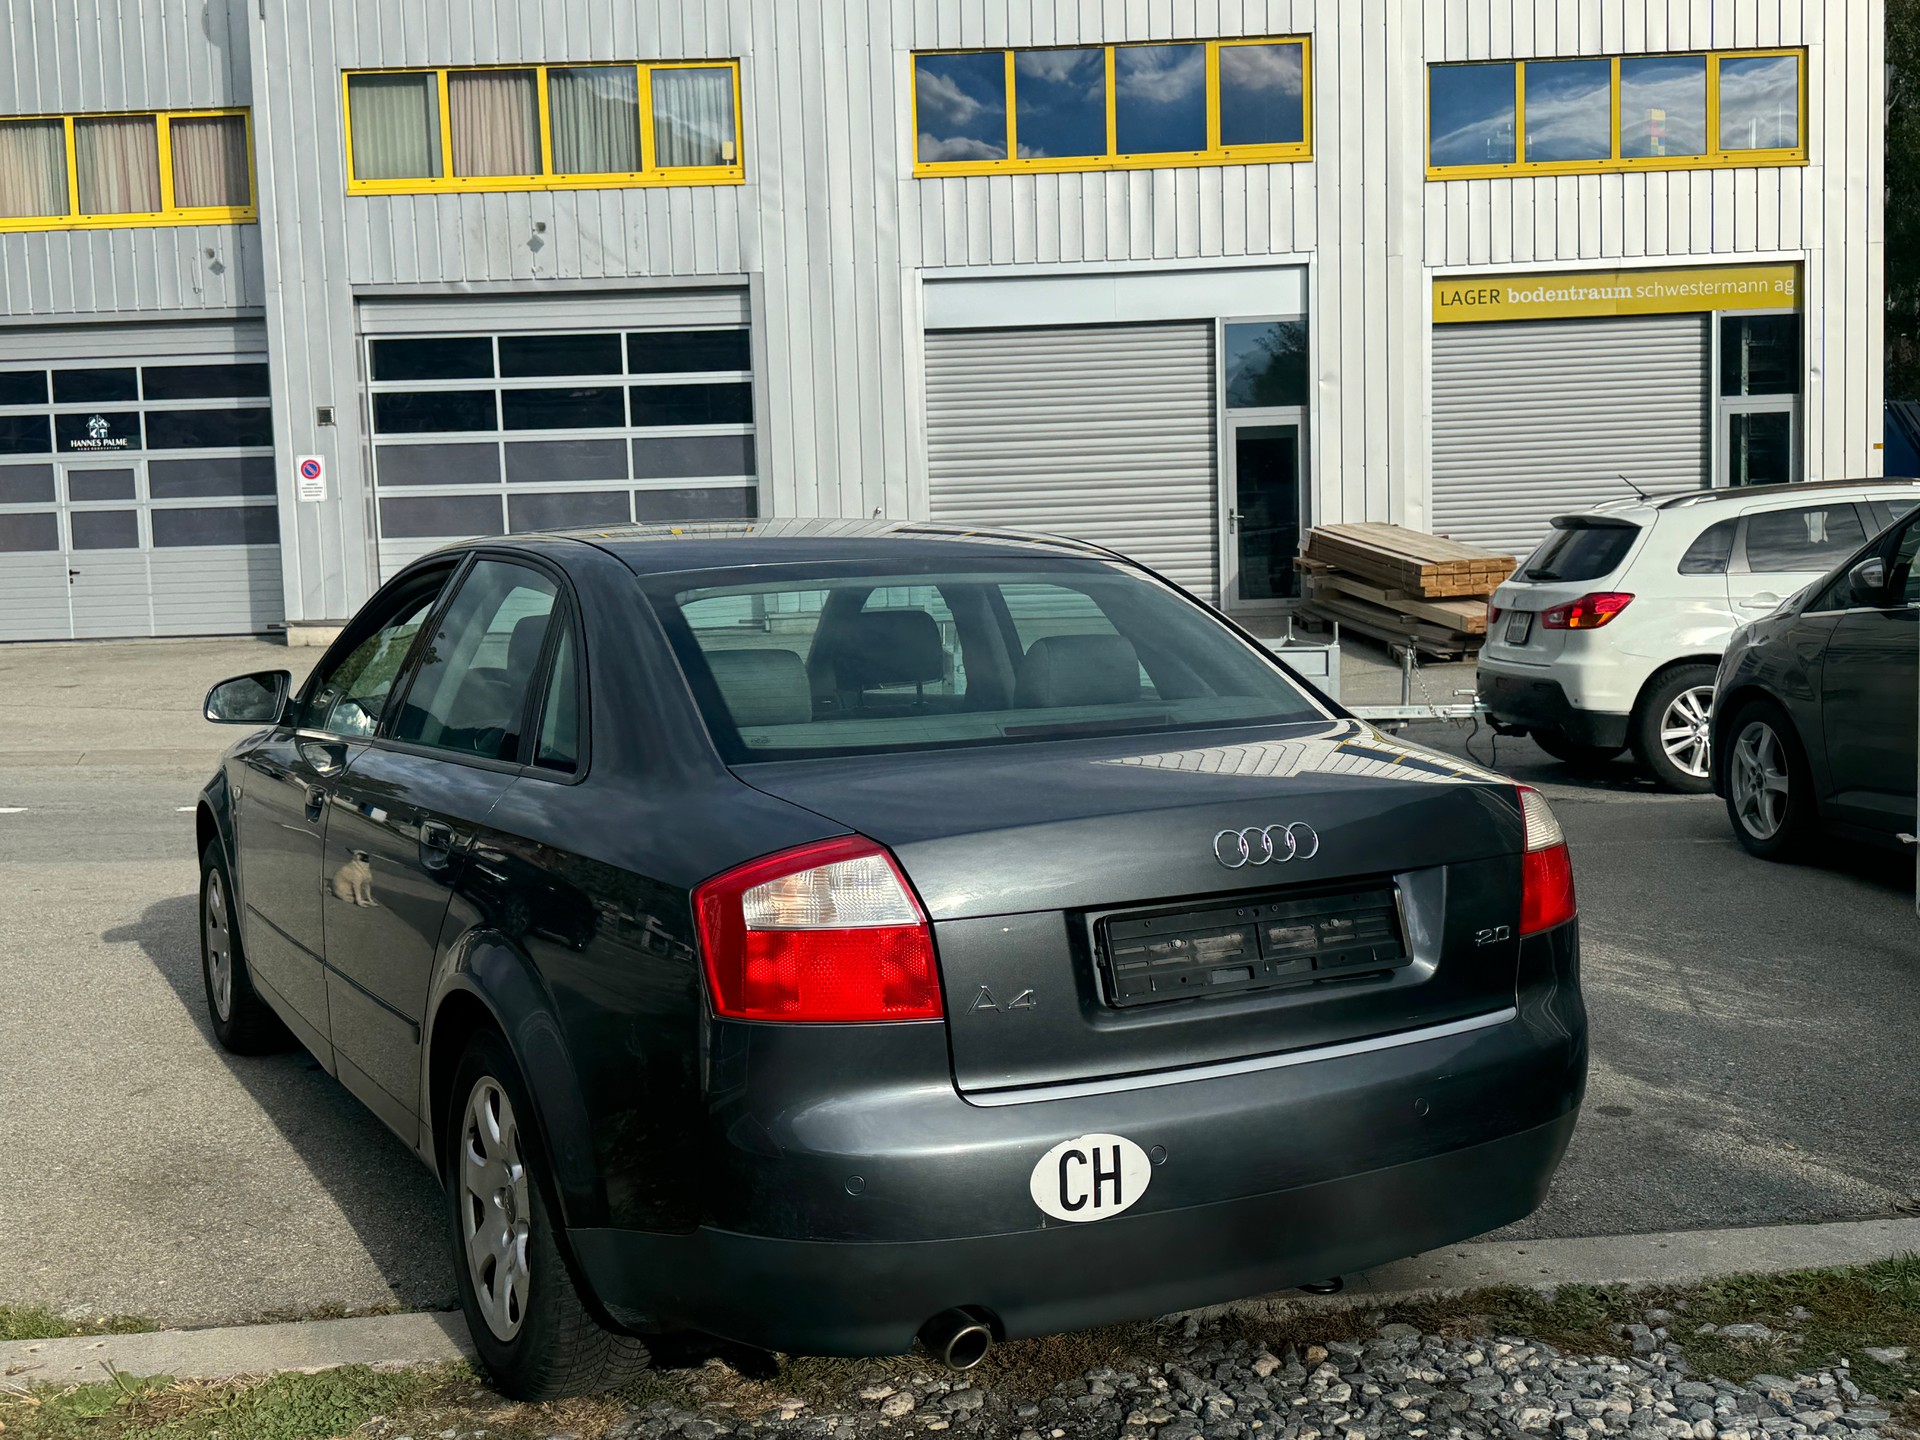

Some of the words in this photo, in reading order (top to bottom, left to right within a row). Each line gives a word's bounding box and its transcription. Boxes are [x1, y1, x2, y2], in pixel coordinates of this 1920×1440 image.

[1440, 289, 1501, 306] LAGER
[1507, 285, 1633, 304] bodentraum
[1636, 280, 1769, 298] schwestermann
[1774, 279, 1795, 295] ag
[70, 439, 102, 448] HANNES
[103, 438, 128, 447] PALME
[966, 985, 1037, 1015] A4
[1058, 1144, 1122, 1212] CH
